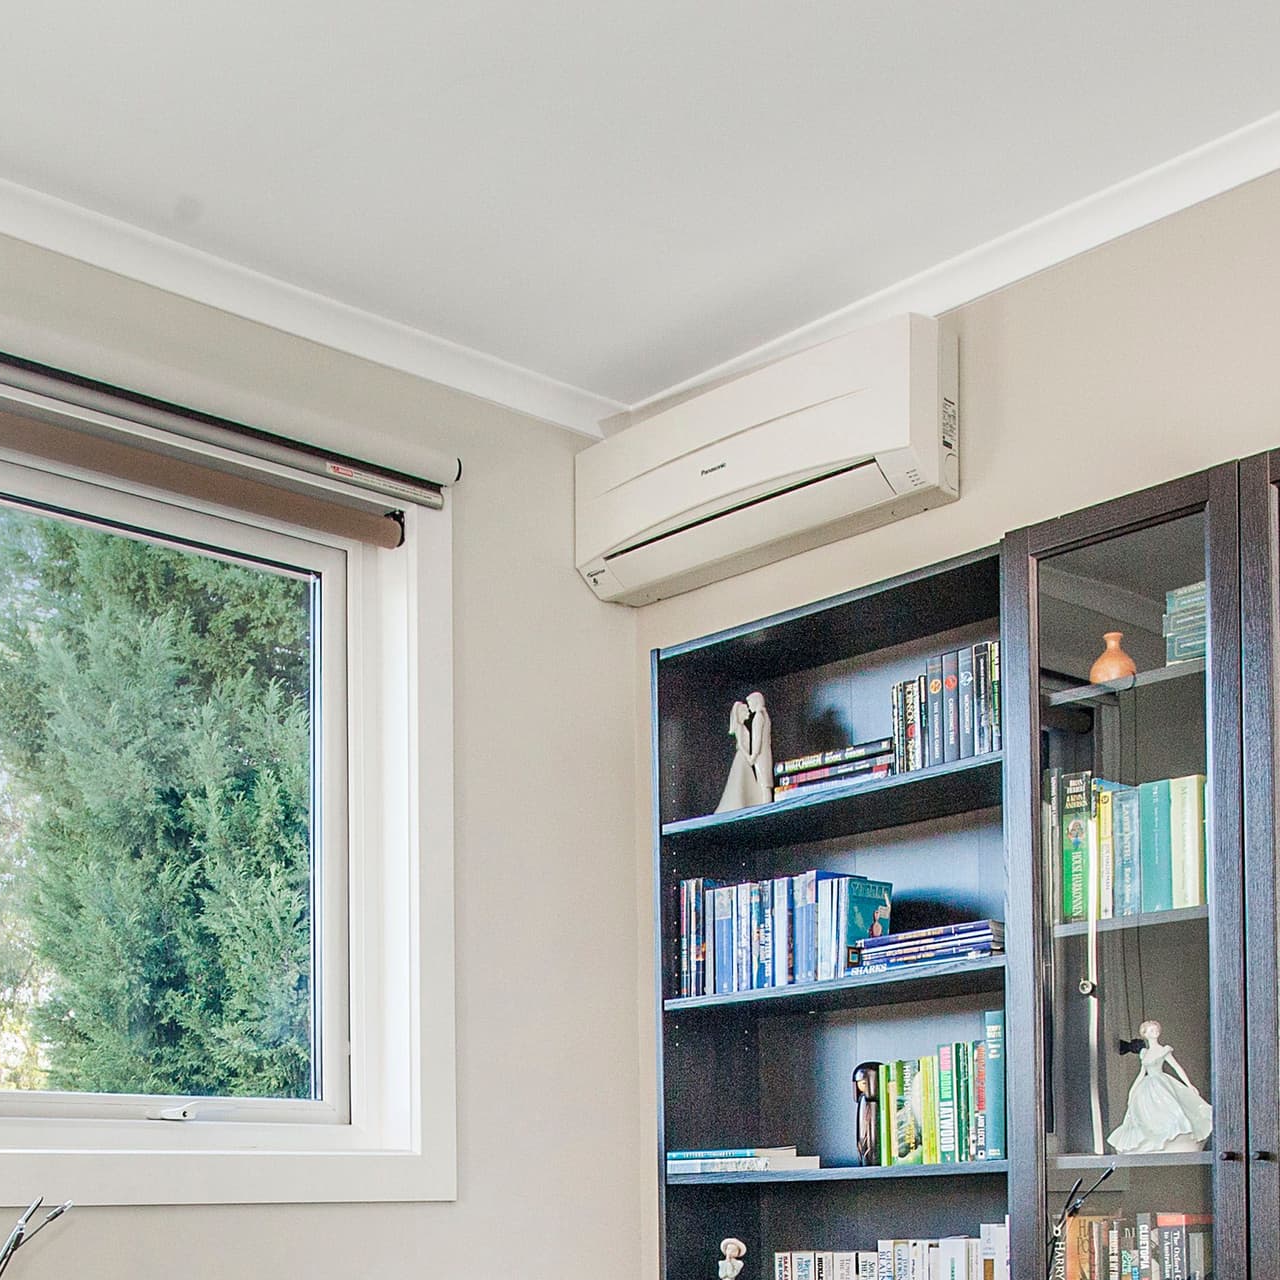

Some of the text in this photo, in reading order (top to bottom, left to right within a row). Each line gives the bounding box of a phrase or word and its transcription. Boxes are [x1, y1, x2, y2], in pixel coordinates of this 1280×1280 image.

[850, 963, 888, 976] SHARKS
[940, 1107, 954, 1152] ATWOOD
[1055, 1241, 1066, 1280] HARRY
[1139, 1224, 1150, 1270] CLUETOPIA
[1173, 1247, 1181, 1273] Oxford
